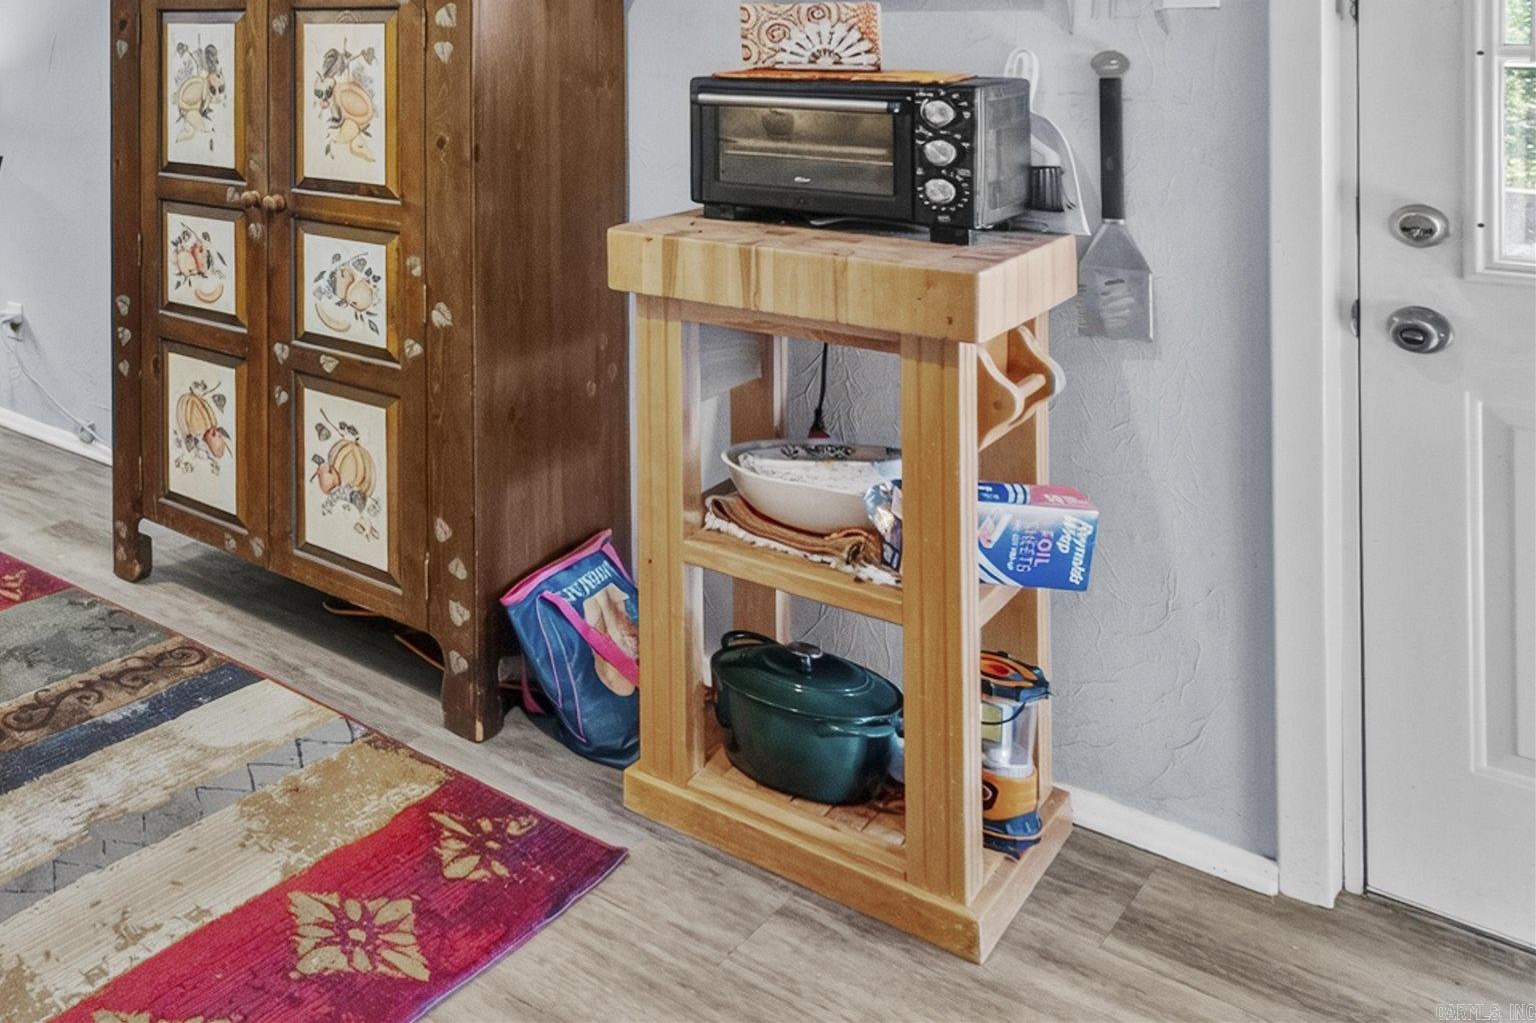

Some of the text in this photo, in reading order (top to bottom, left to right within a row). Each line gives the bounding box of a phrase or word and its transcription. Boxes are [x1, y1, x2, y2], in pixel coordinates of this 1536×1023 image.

[1034, 531, 1054, 567] FOIL
[1056, 515, 1076, 554] Wrap
[1069, 519, 1093, 585] Reynolds
